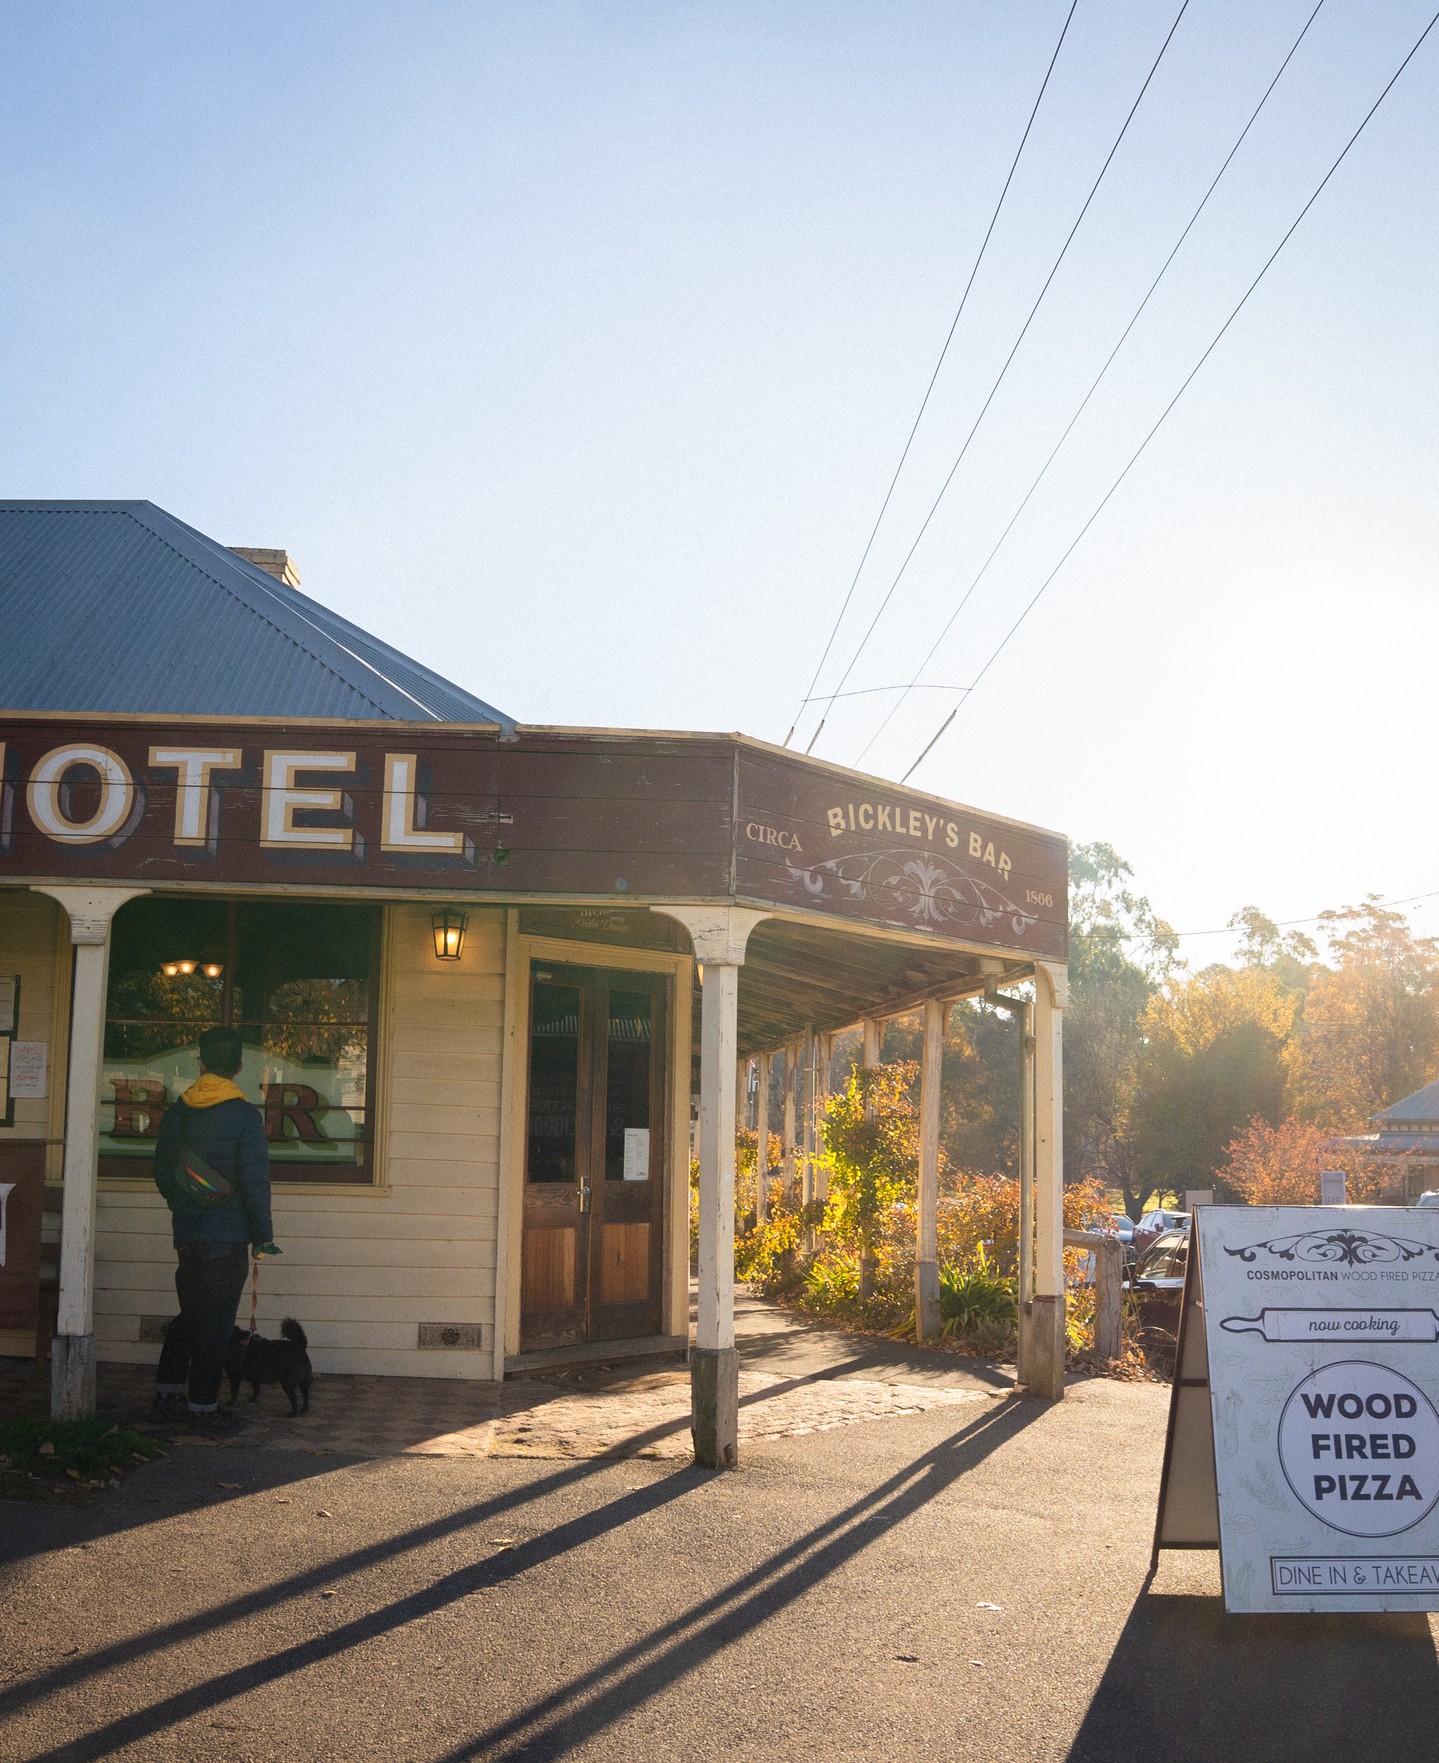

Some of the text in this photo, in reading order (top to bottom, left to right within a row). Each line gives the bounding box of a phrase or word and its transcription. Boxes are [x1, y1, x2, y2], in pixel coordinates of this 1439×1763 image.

[0, 742, 465, 854] OTEL
[745, 822, 803, 852] CIRCA
[826, 803, 1013, 881] BICKLEY'S BAR
[1025, 889, 1054, 908] 1866
[110, 1078, 327, 1142] BR
[1246, 1270, 1338, 1281] COSMOPOLITAN
[1341, 1271, 1378, 1281] WOOD
[1381, 1271, 1409, 1281] FIRED
[1309, 1315, 1401, 1336] now cooking
[1301, 1393, 1417, 1419] WOOD
[1311, 1433, 1416, 1459] FIRED
[1313, 1474, 1423, 1501] PIZZA
[1279, 1566, 1322, 1585] DINE
[1329, 1566, 1347, 1585] IN
[1353, 1565, 1366, 1585] &
